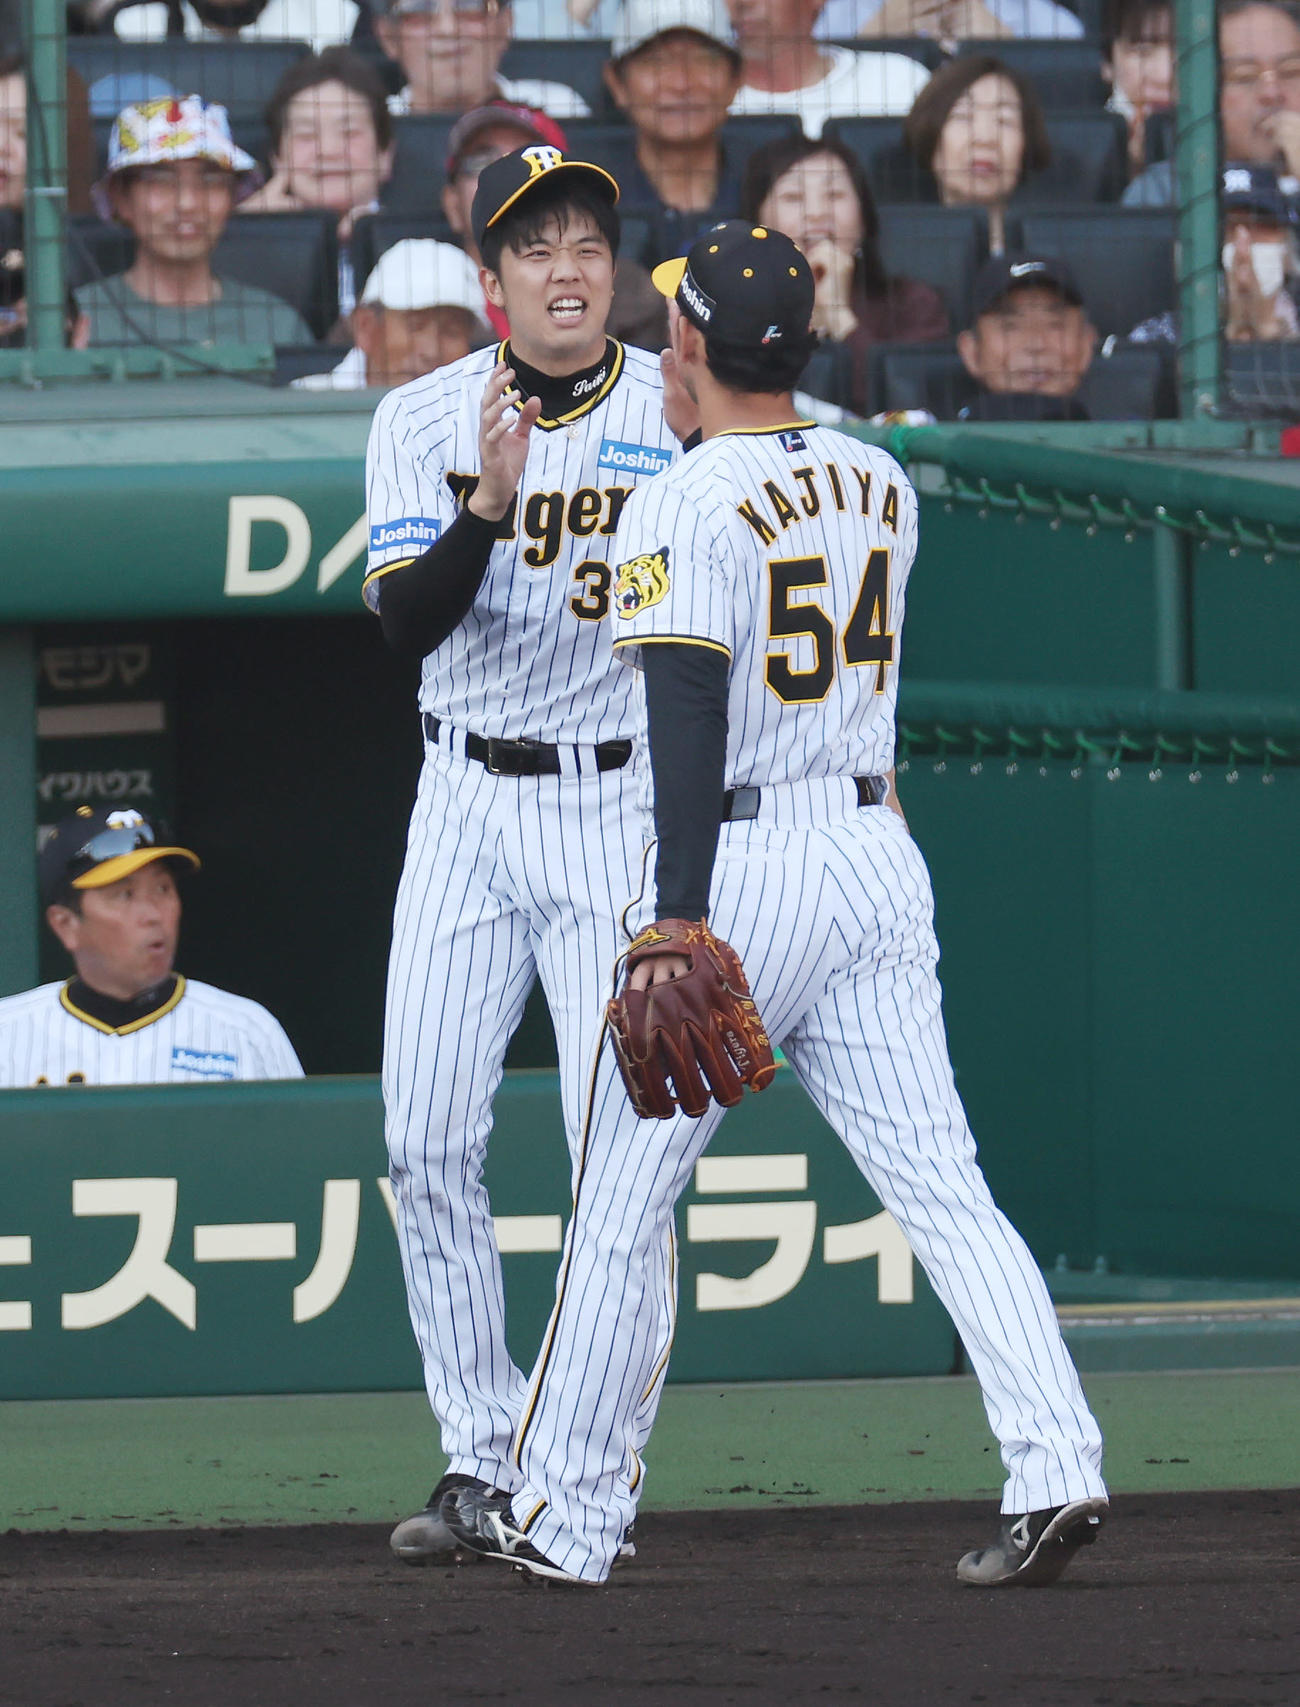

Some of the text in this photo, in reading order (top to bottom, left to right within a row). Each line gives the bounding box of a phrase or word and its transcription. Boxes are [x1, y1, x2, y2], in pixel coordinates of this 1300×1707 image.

[572, 366, 606, 397] Saiki
[599, 445, 670, 472] Joshin
[736, 462, 899, 547] KAJIYA
[372, 521, 437, 546] Joshin
[764, 547, 895, 704] 54
